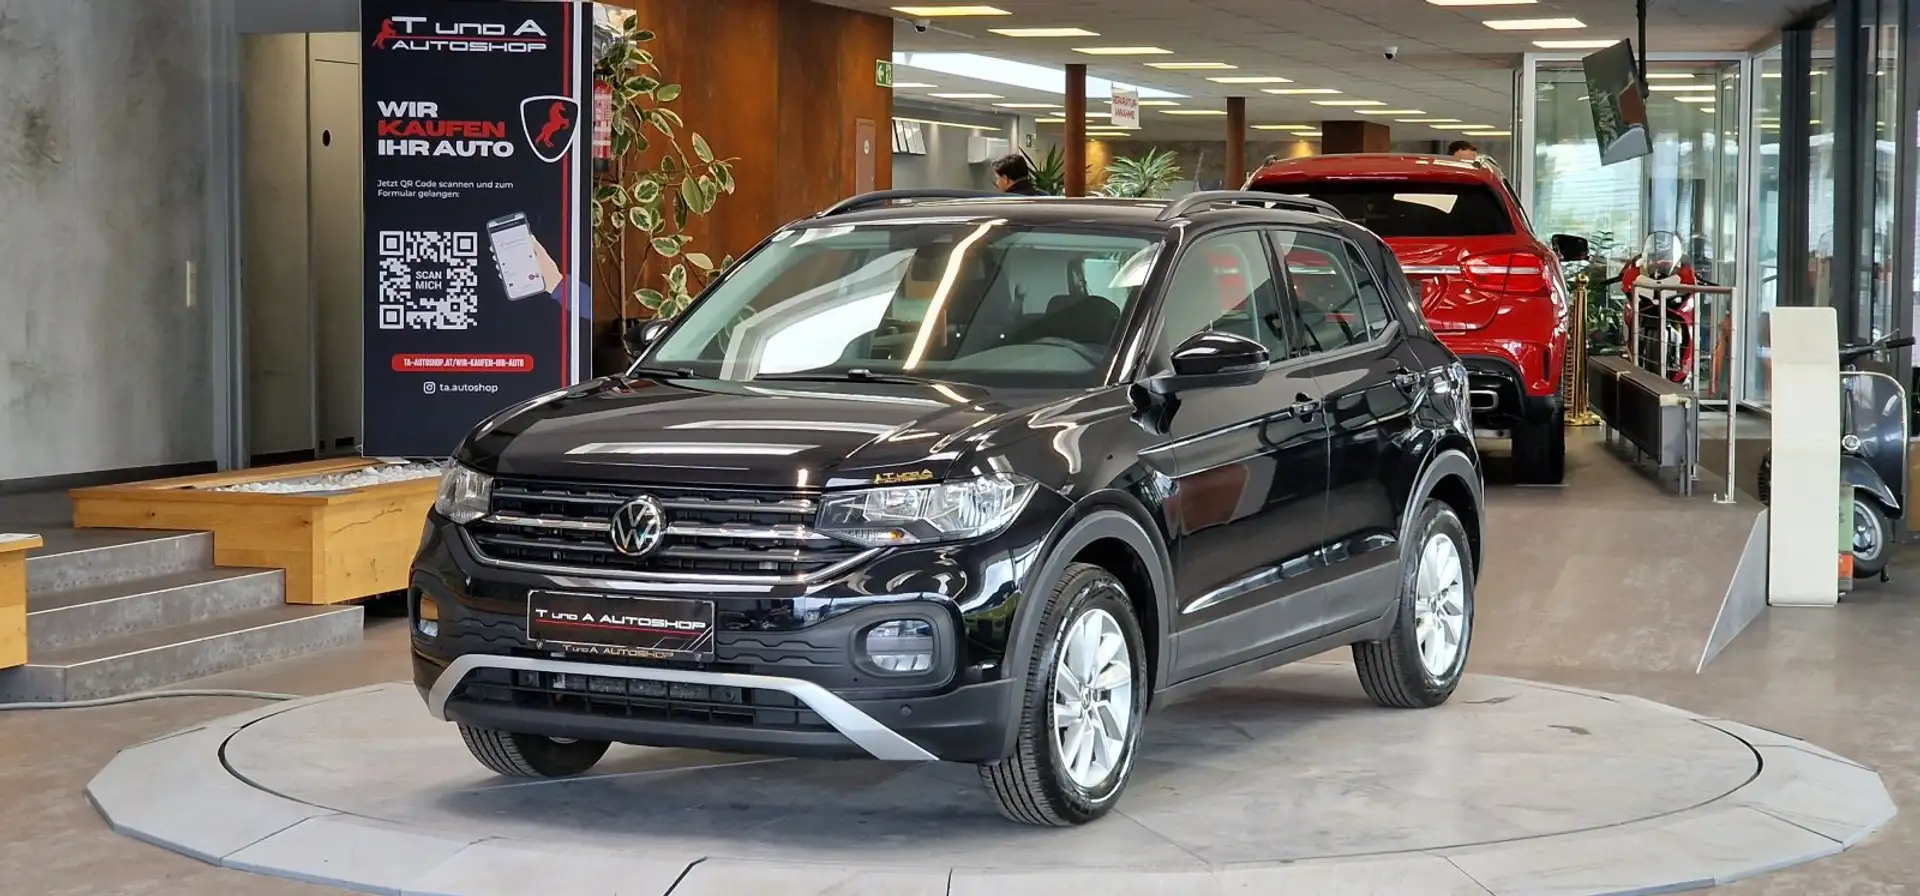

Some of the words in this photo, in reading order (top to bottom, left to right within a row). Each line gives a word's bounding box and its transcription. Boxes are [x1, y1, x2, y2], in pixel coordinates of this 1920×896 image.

[392, 16, 427, 34] T
[513, 19, 547, 36] A
[392, 40, 547, 53] AUTOSHOP
[377, 100, 438, 118] WIR
[377, 120, 506, 138] KAUFEN
[378, 139, 431, 157] IHR
[433, 140, 515, 158] AUTO
[377, 179, 398, 188] Jetzt
[400, 180, 413, 188] QR
[415, 180, 437, 188] Code
[438, 181, 474, 189] scannen
[476, 180, 493, 189] und
[377, 189, 416, 198] Formular
[418, 190, 460, 199] gelangen:
[415, 270, 442, 280] SCAN
[415, 281, 442, 290] MICH
[439, 383, 499, 394] ta.autoshop
[535, 608, 548, 618] T
[582, 613, 595, 622] A
[599, 614, 706, 630] AUTOSHOP
[562, 644, 574, 652] T
[587, 646, 599, 654] A
[602, 648, 675, 659] AUTOSHOP
